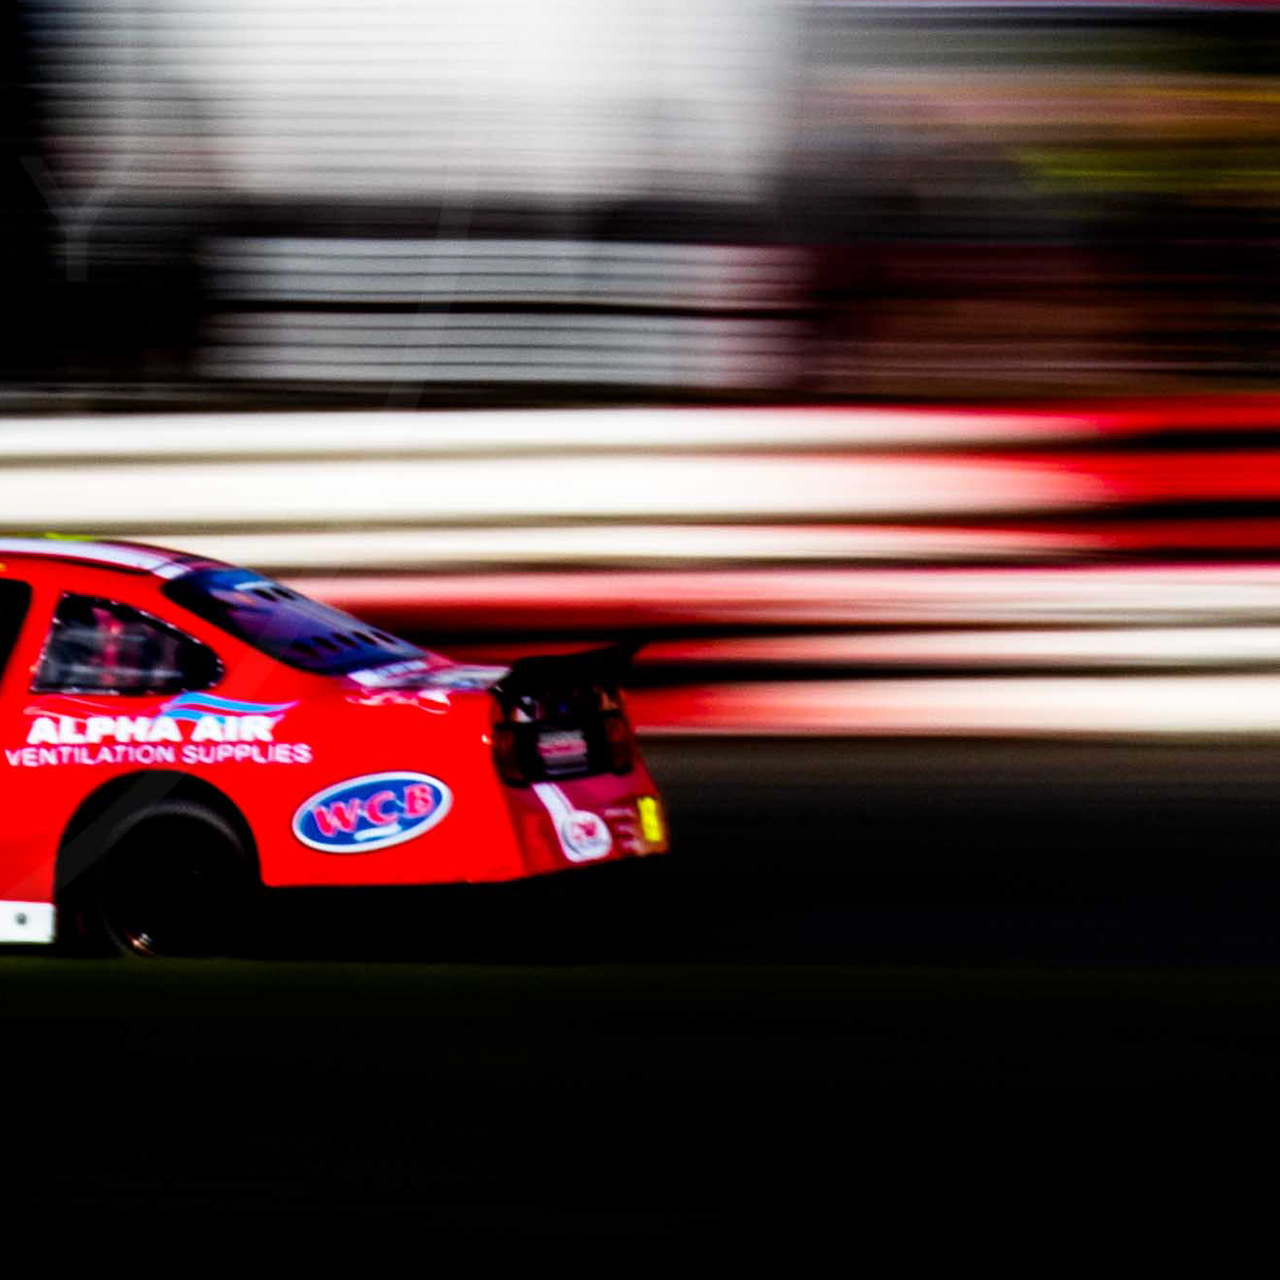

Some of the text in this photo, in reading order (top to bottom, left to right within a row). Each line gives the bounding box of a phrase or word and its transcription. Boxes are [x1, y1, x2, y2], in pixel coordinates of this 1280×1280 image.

[26, 716, 276, 744] ALPHA AIR
[5, 743, 313, 766] VENTILATION SUPPLIES
